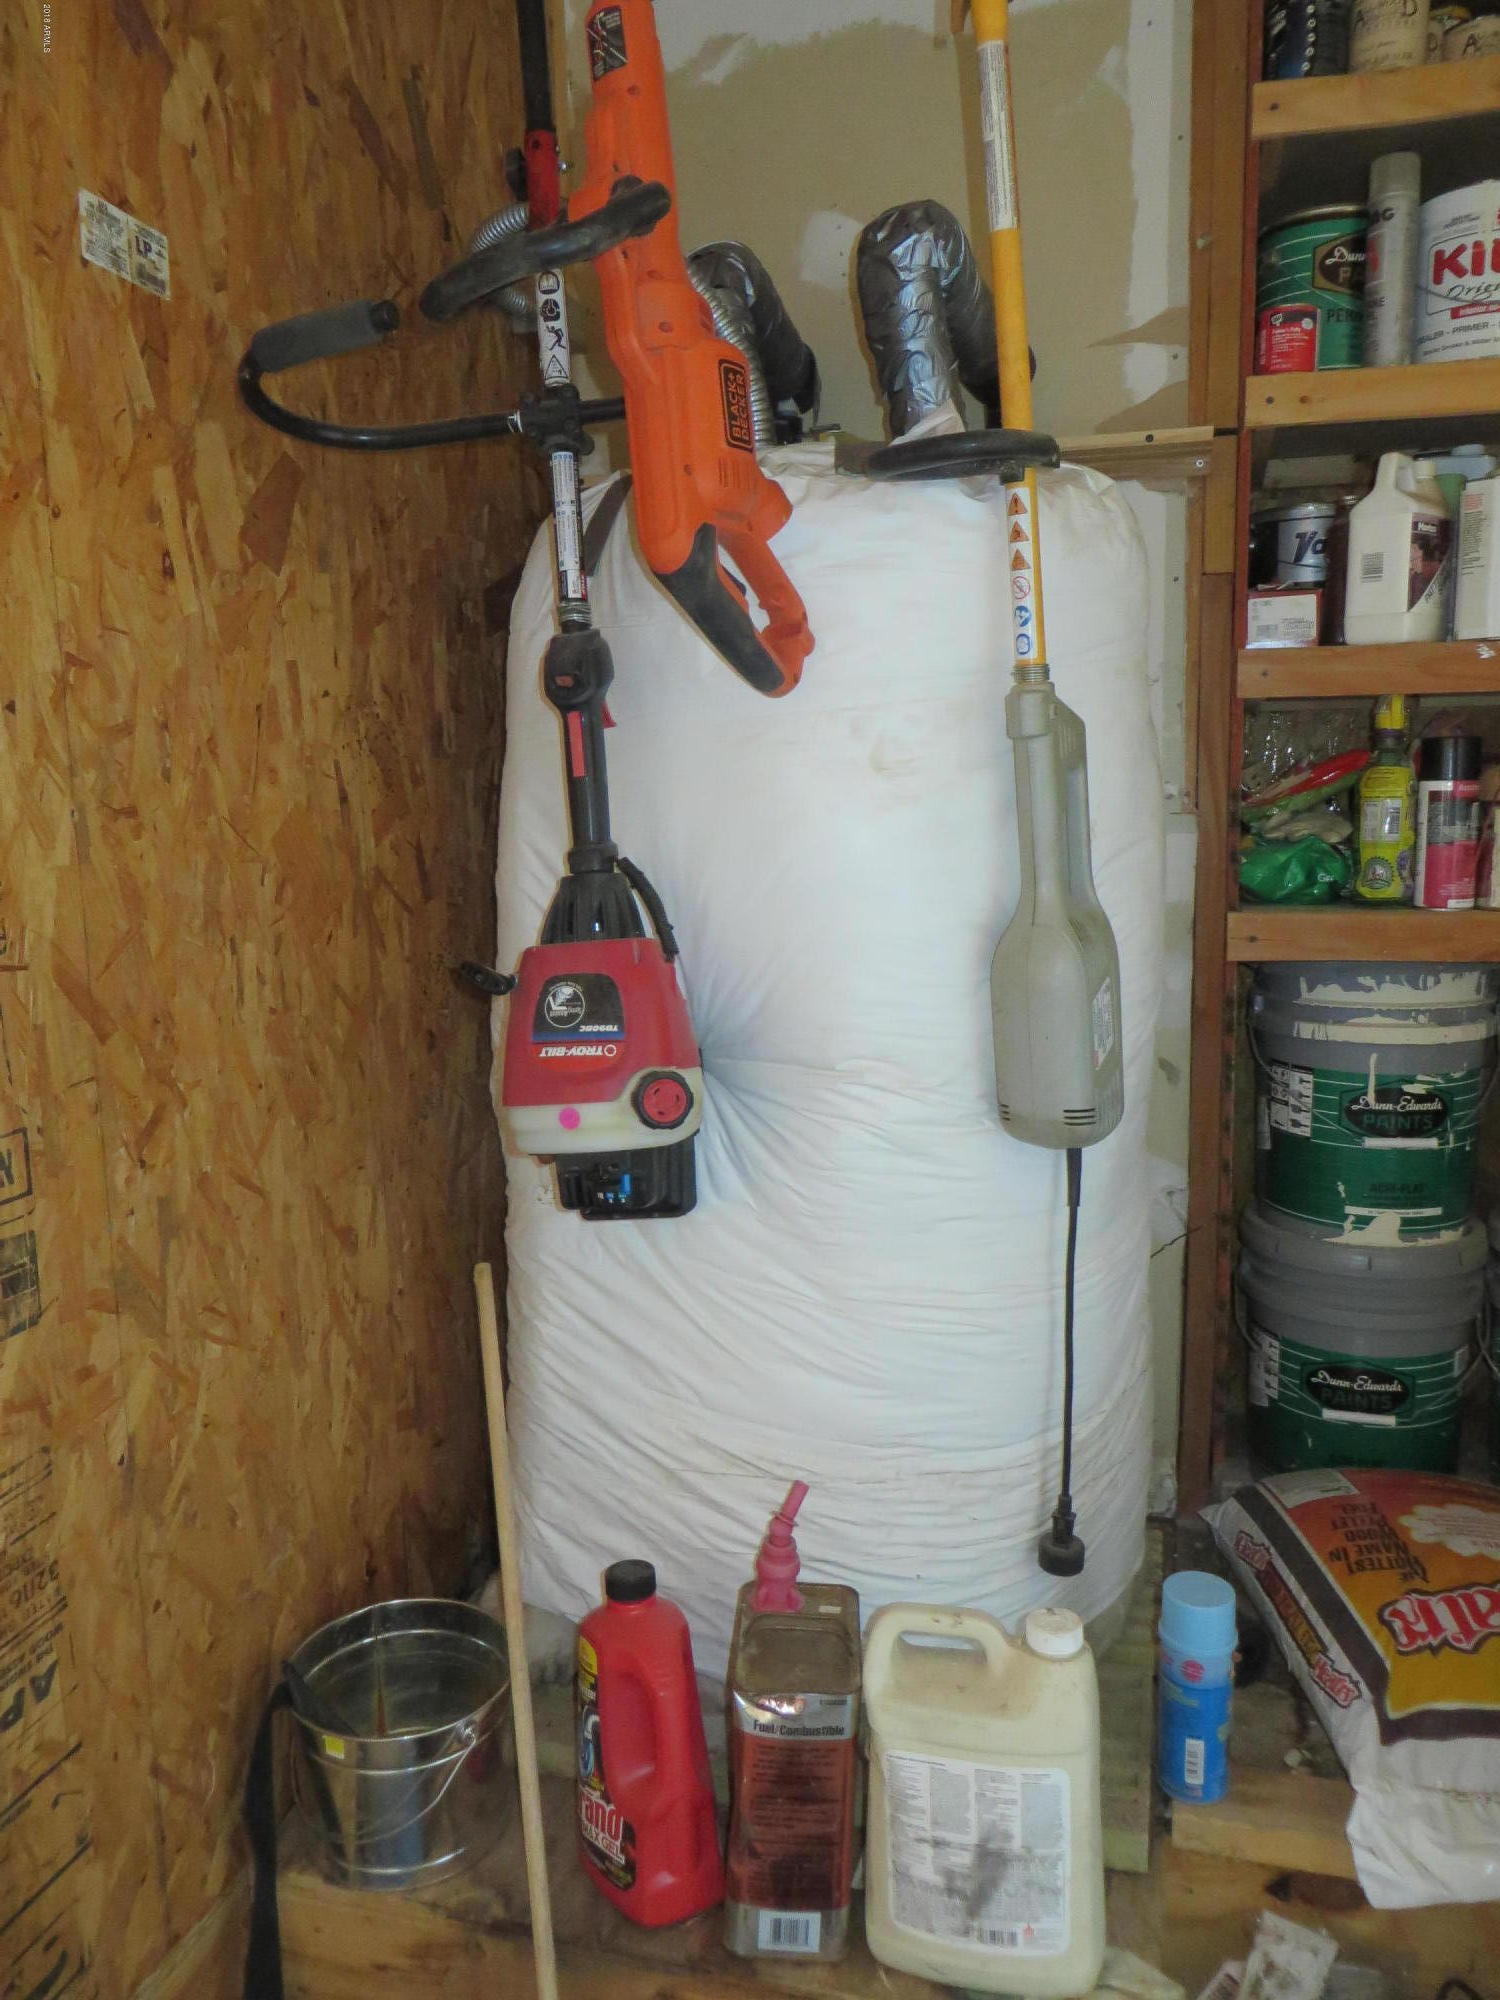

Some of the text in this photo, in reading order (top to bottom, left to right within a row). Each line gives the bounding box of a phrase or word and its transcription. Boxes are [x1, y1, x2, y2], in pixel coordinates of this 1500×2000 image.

[1351, 1095, 1443, 1112] Dunn-Edwards
[1363, 1114, 1433, 1130] PAINTS
[1310, 1369, 1403, 1392] Dunn-Edwards
[1321, 1389, 1392, 1409] PAINTS
